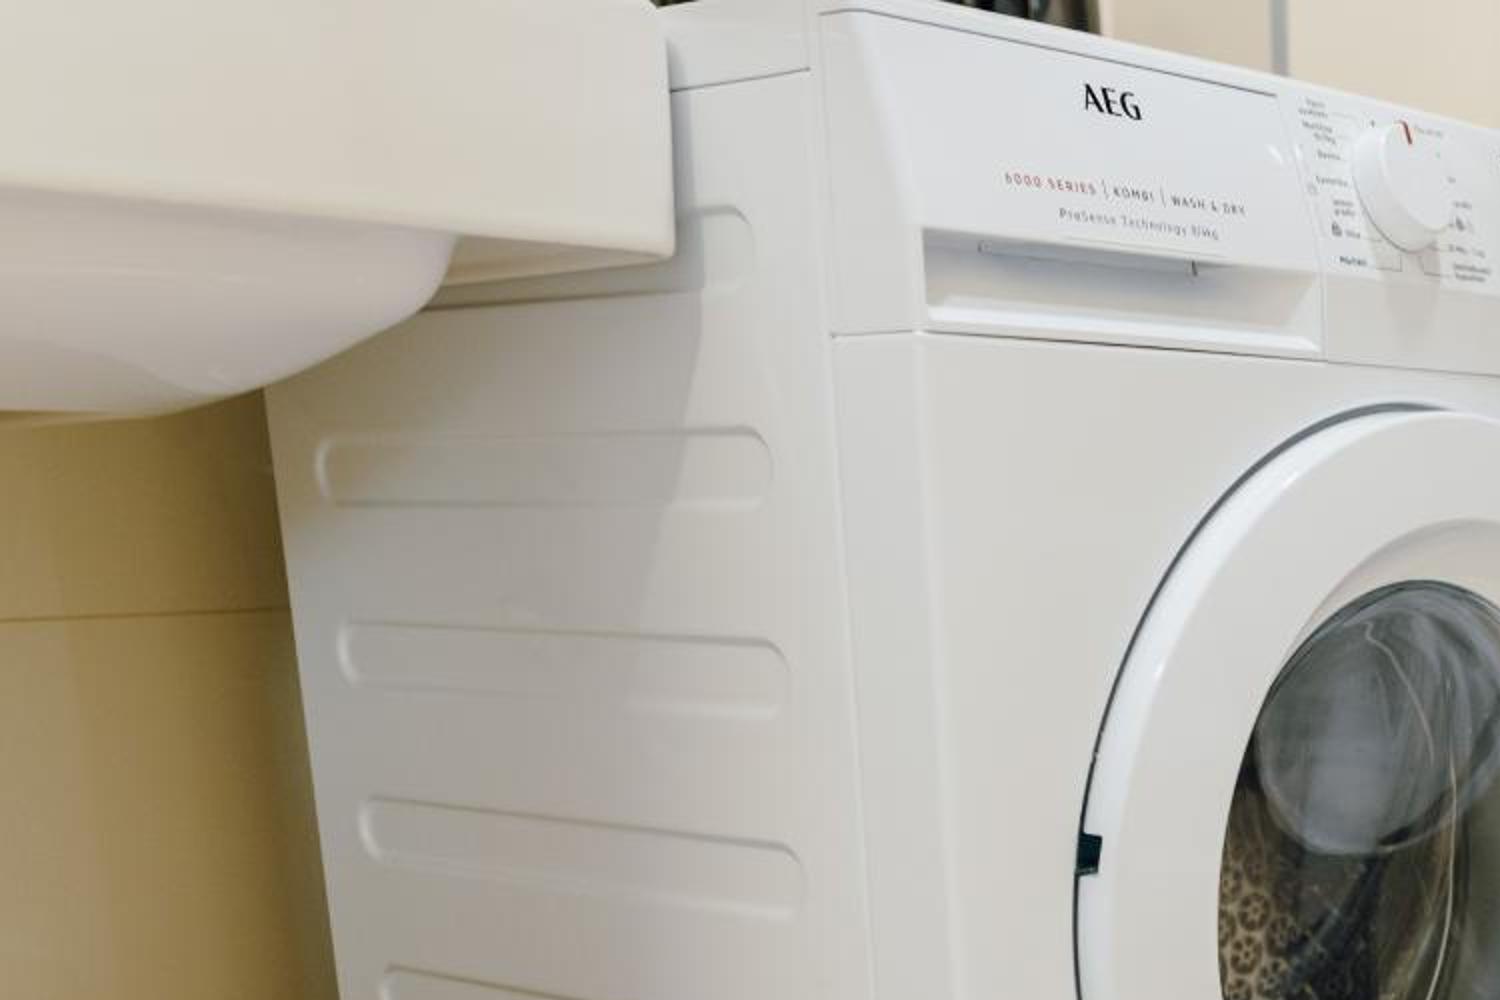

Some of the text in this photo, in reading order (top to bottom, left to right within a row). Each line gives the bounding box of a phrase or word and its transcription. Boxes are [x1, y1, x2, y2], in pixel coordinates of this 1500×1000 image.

[1085, 83, 1142, 120] AEG
[1005, 173, 1040, 187] 6000
[1047, 178, 1096, 195] SERIES
[1112, 187, 1154, 202] KOMBI
[1170, 196, 1205, 209] WASH
[1223, 202, 1245, 216] DRY
[1059, 207, 1116, 224] ProSense
[1121, 216, 1187, 237] Technology
